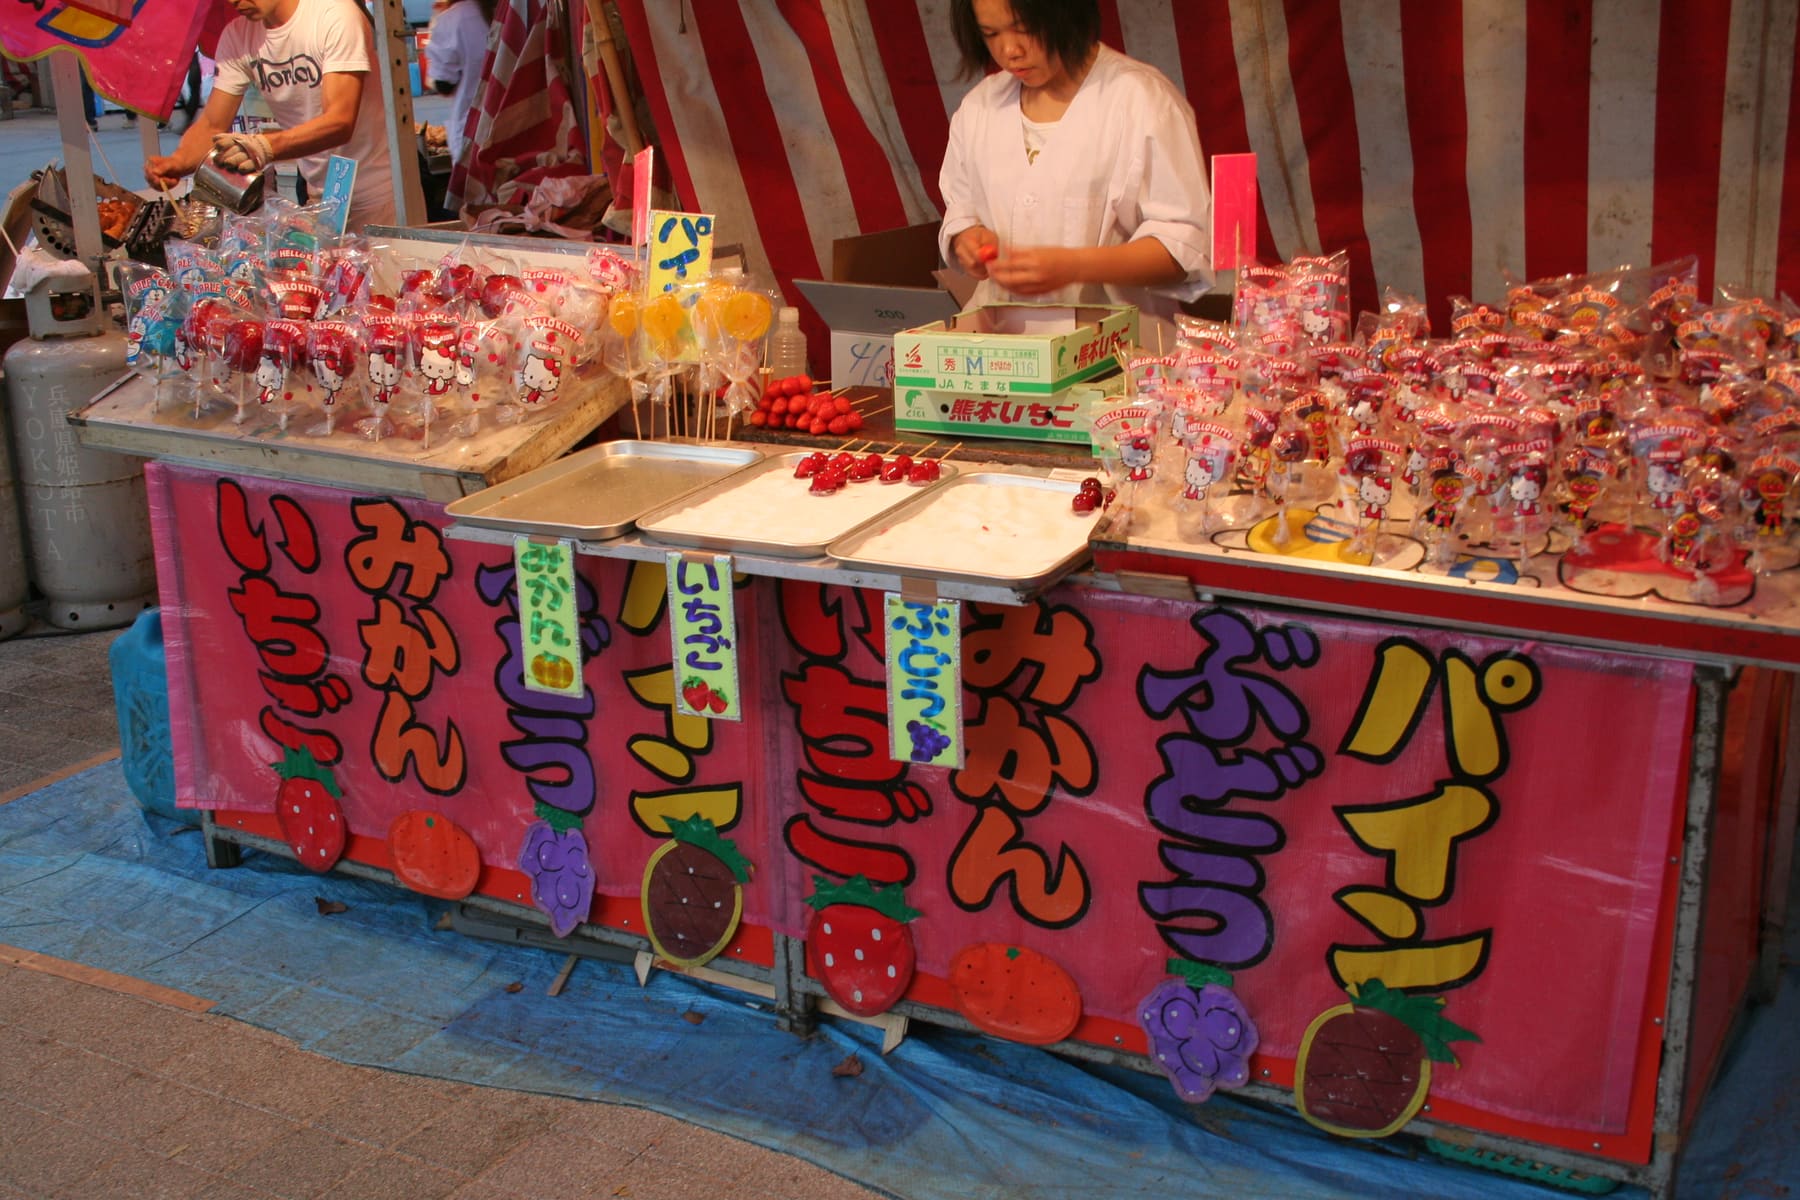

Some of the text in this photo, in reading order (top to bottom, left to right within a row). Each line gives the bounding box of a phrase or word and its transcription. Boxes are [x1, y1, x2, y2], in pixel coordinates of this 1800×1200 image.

[938, 379, 955, 390] JA
[943, 357, 957, 372] 秀
[949, 398, 1080, 428] 熊本いちご
[966, 356, 984, 376] M
[1097, 408, 1147, 429] HELLO KITTY
[22, 386, 62, 561] YOKOTA
[1187, 422, 1233, 440] HELLO KITTY
[217, 478, 352, 766] いちご
[345, 496, 467, 796] みかん
[520, 543, 572, 648] みかん
[677, 560, 732, 671] いちご
[891, 602, 952, 718] ぶどう
[946, 597, 1102, 930] みかん
[1136, 606, 1325, 971] ぶどう
[1325, 635, 1543, 993] パイン
